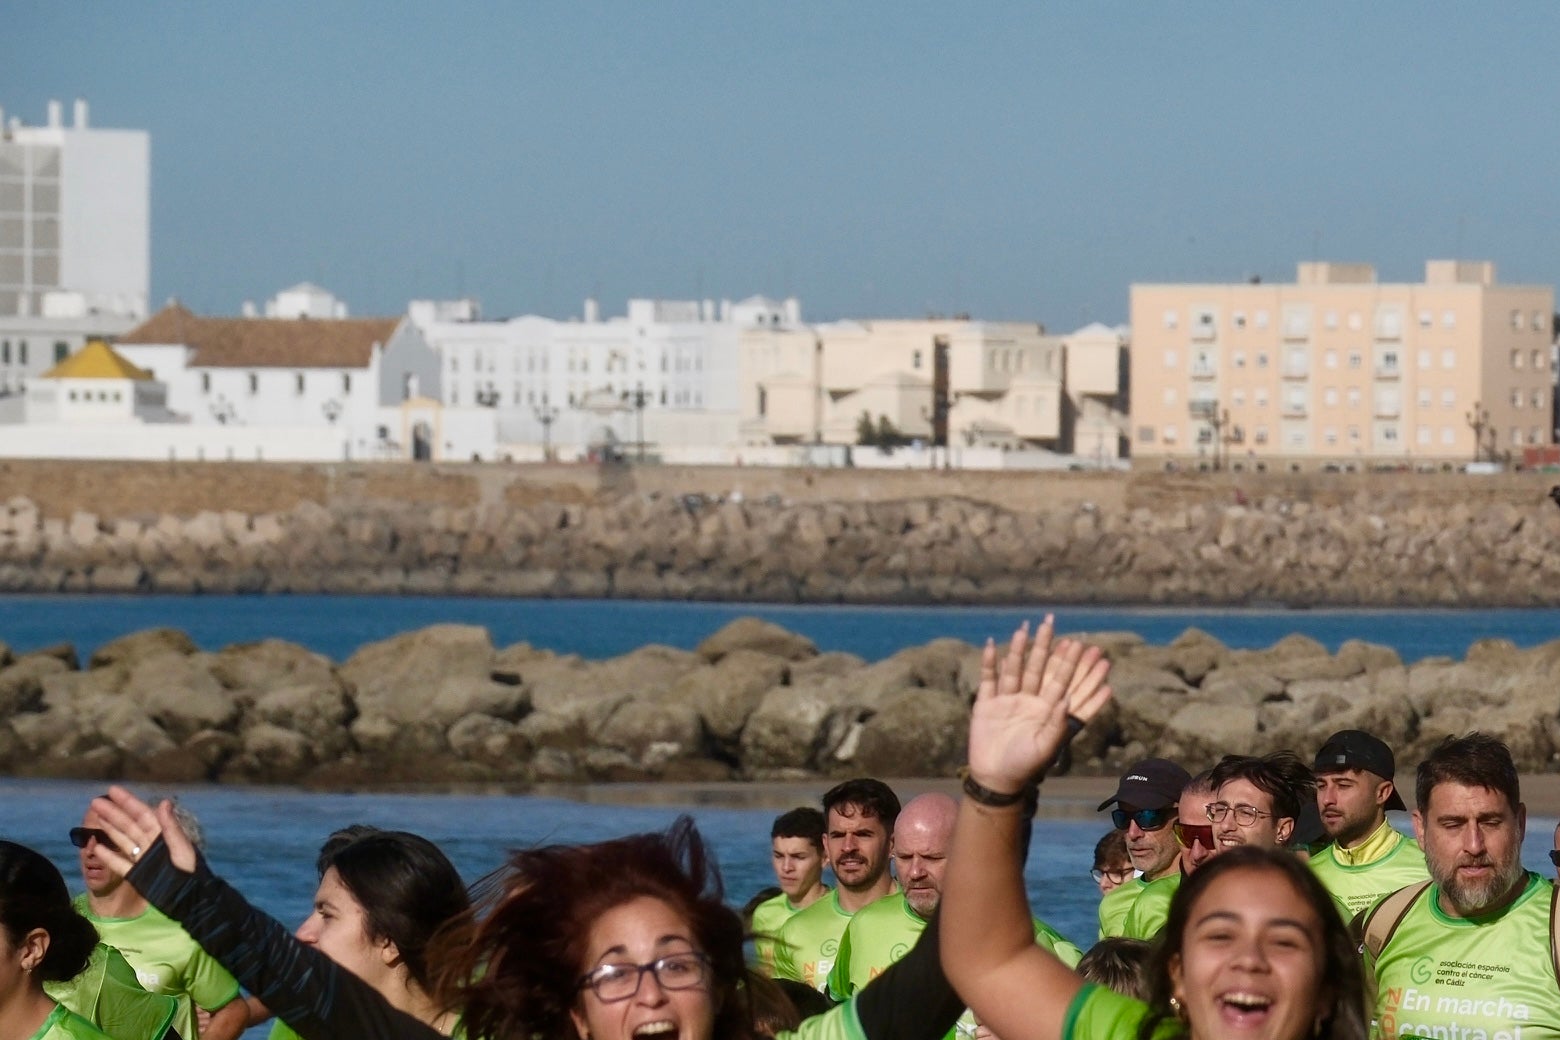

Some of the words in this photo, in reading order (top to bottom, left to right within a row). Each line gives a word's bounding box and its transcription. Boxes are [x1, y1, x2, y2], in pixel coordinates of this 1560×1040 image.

[1439, 960, 1476, 970] asociación
[1477, 963, 1511, 974] española
[1436, 969, 1461, 978] contra
[1461, 970, 1469, 978] el
[1468, 971, 1494, 981] cáncer
[1445, 978, 1466, 987] Cádiz
[1402, 988, 1430, 1012] En
[1436, 997, 1530, 1021] marcha
